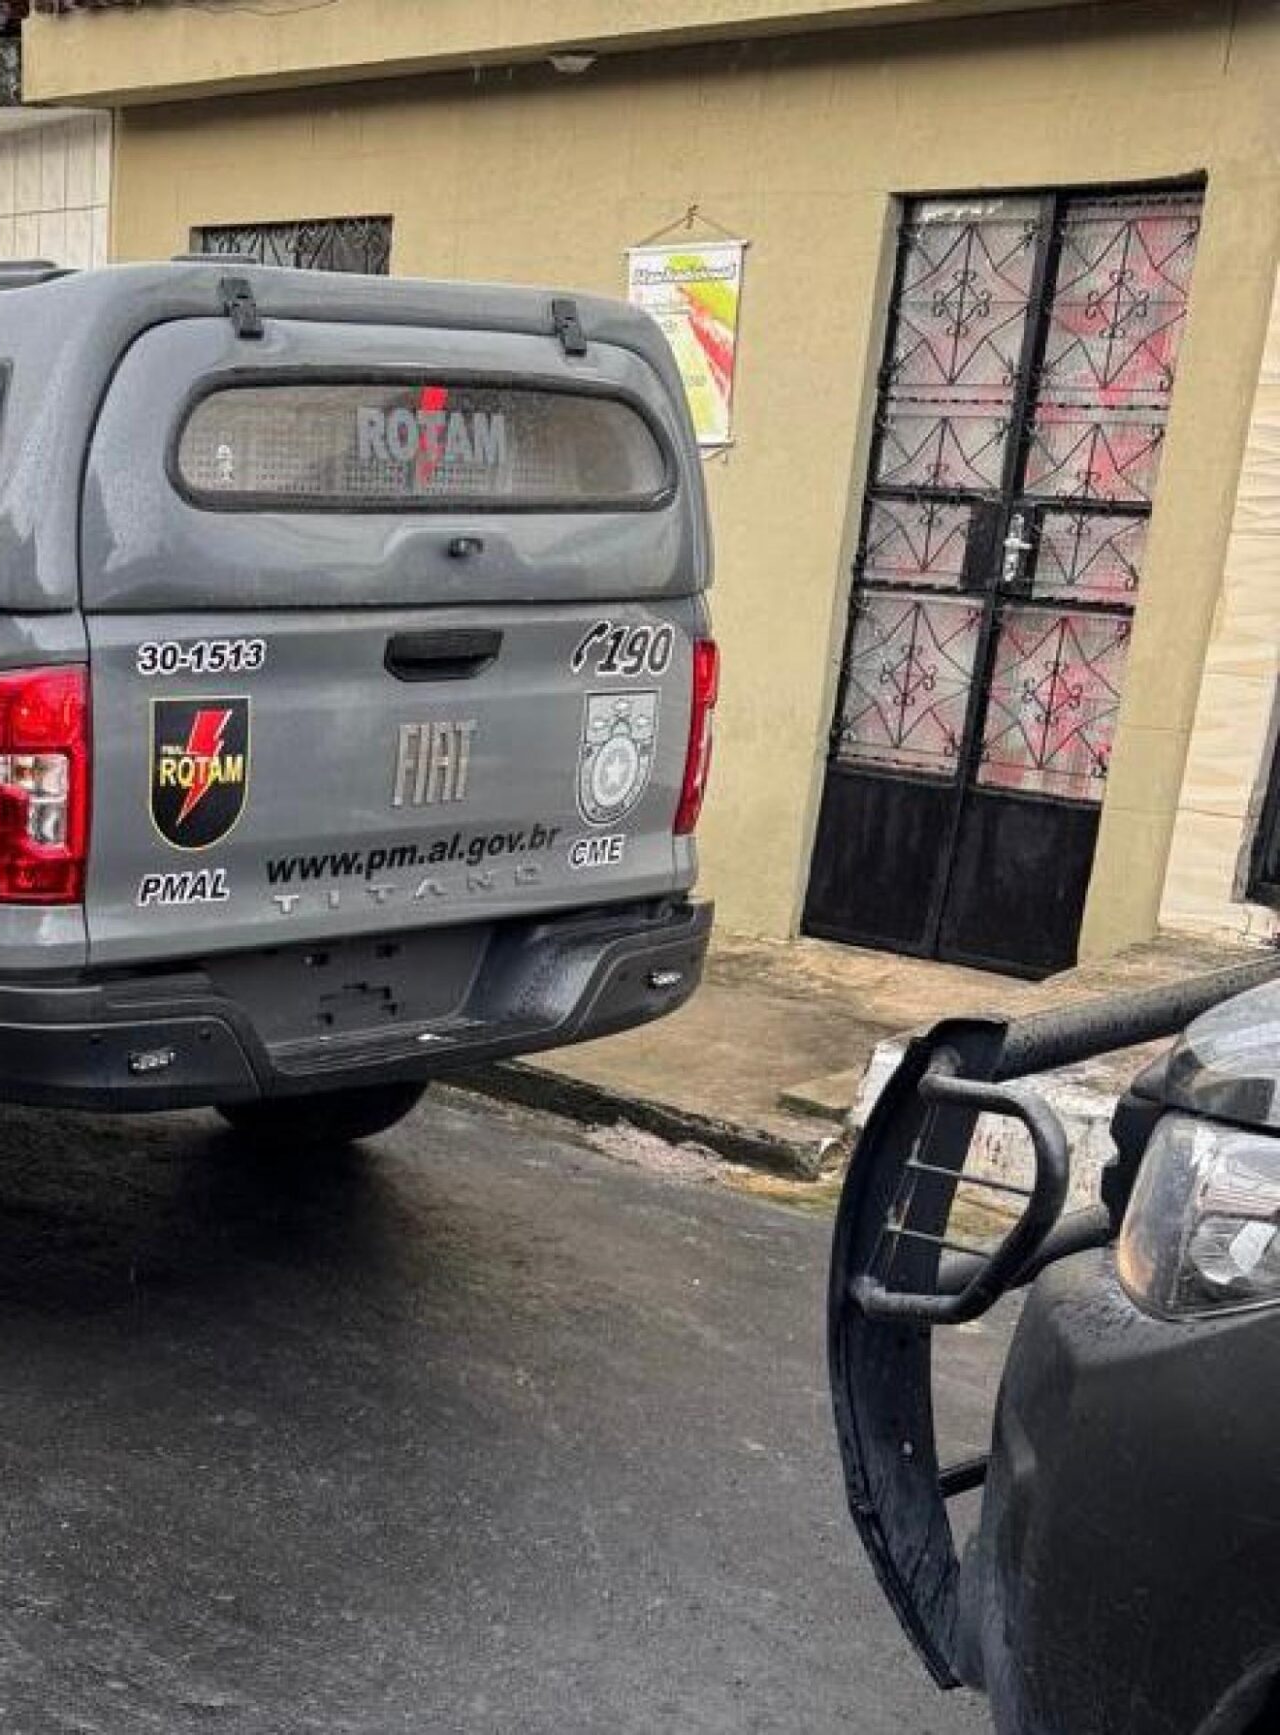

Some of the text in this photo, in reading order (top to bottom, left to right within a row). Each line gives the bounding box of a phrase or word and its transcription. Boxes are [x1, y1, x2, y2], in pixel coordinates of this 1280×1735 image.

[357, 407, 508, 466] ROTAM
[137, 639, 266, 675] 30-1513
[595, 625, 675, 677] 190
[159, 753, 243, 787] ROTAM
[392, 719, 477, 807] FIAT
[267, 823, 562, 884] www.pm.al.gov.br
[568, 834, 624, 868] CME
[138, 868, 230, 907] PMAL
[272, 862, 542, 915] TITANO
